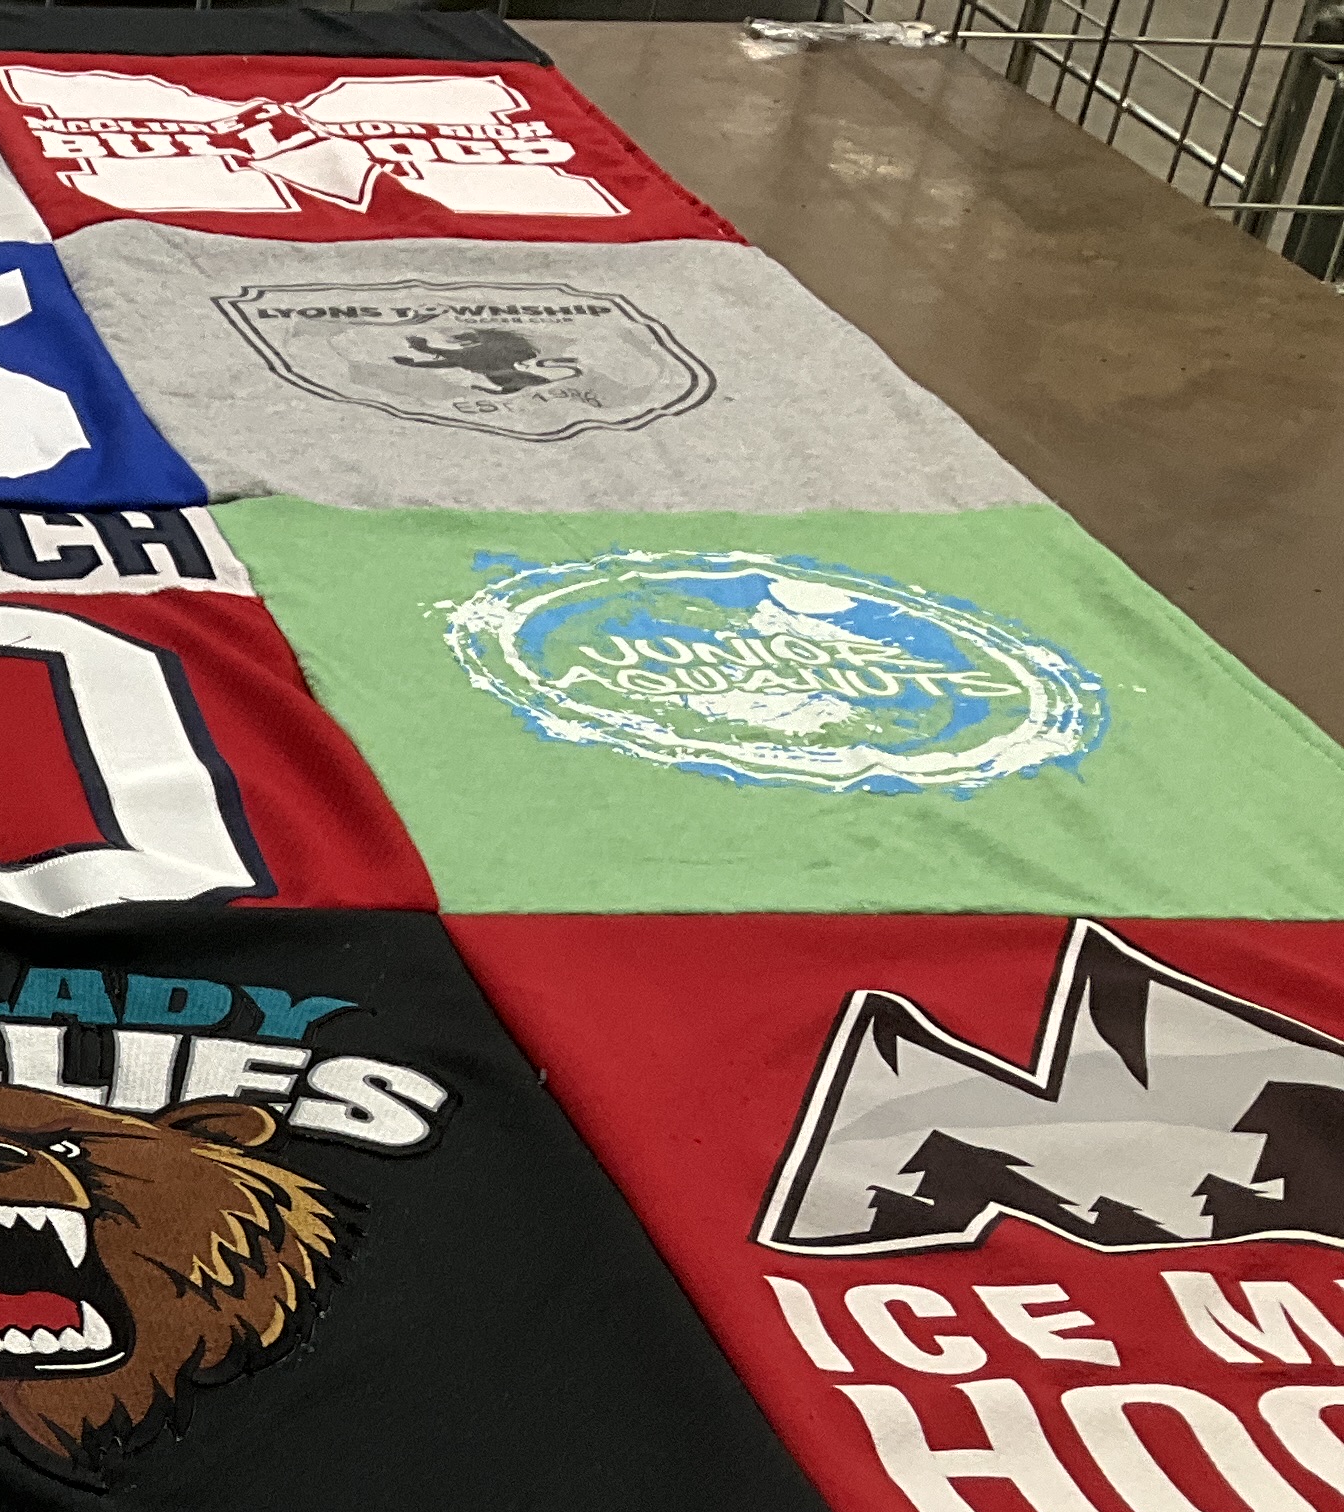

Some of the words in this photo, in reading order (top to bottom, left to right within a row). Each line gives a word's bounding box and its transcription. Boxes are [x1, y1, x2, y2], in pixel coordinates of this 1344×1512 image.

[30, 122, 576, 165] BULLOGS
[436, 120, 553, 141] HIGH
[257, 304, 384, 319] LYONS
[391, 303, 613, 318] TOWNSHIP
[578, 634, 944, 667] JUNIOR
[547, 666, 1023, 698] AQUANUTS
[763, 1274, 1121, 1375] ICE
[1160, 1269, 1344, 1367] M
